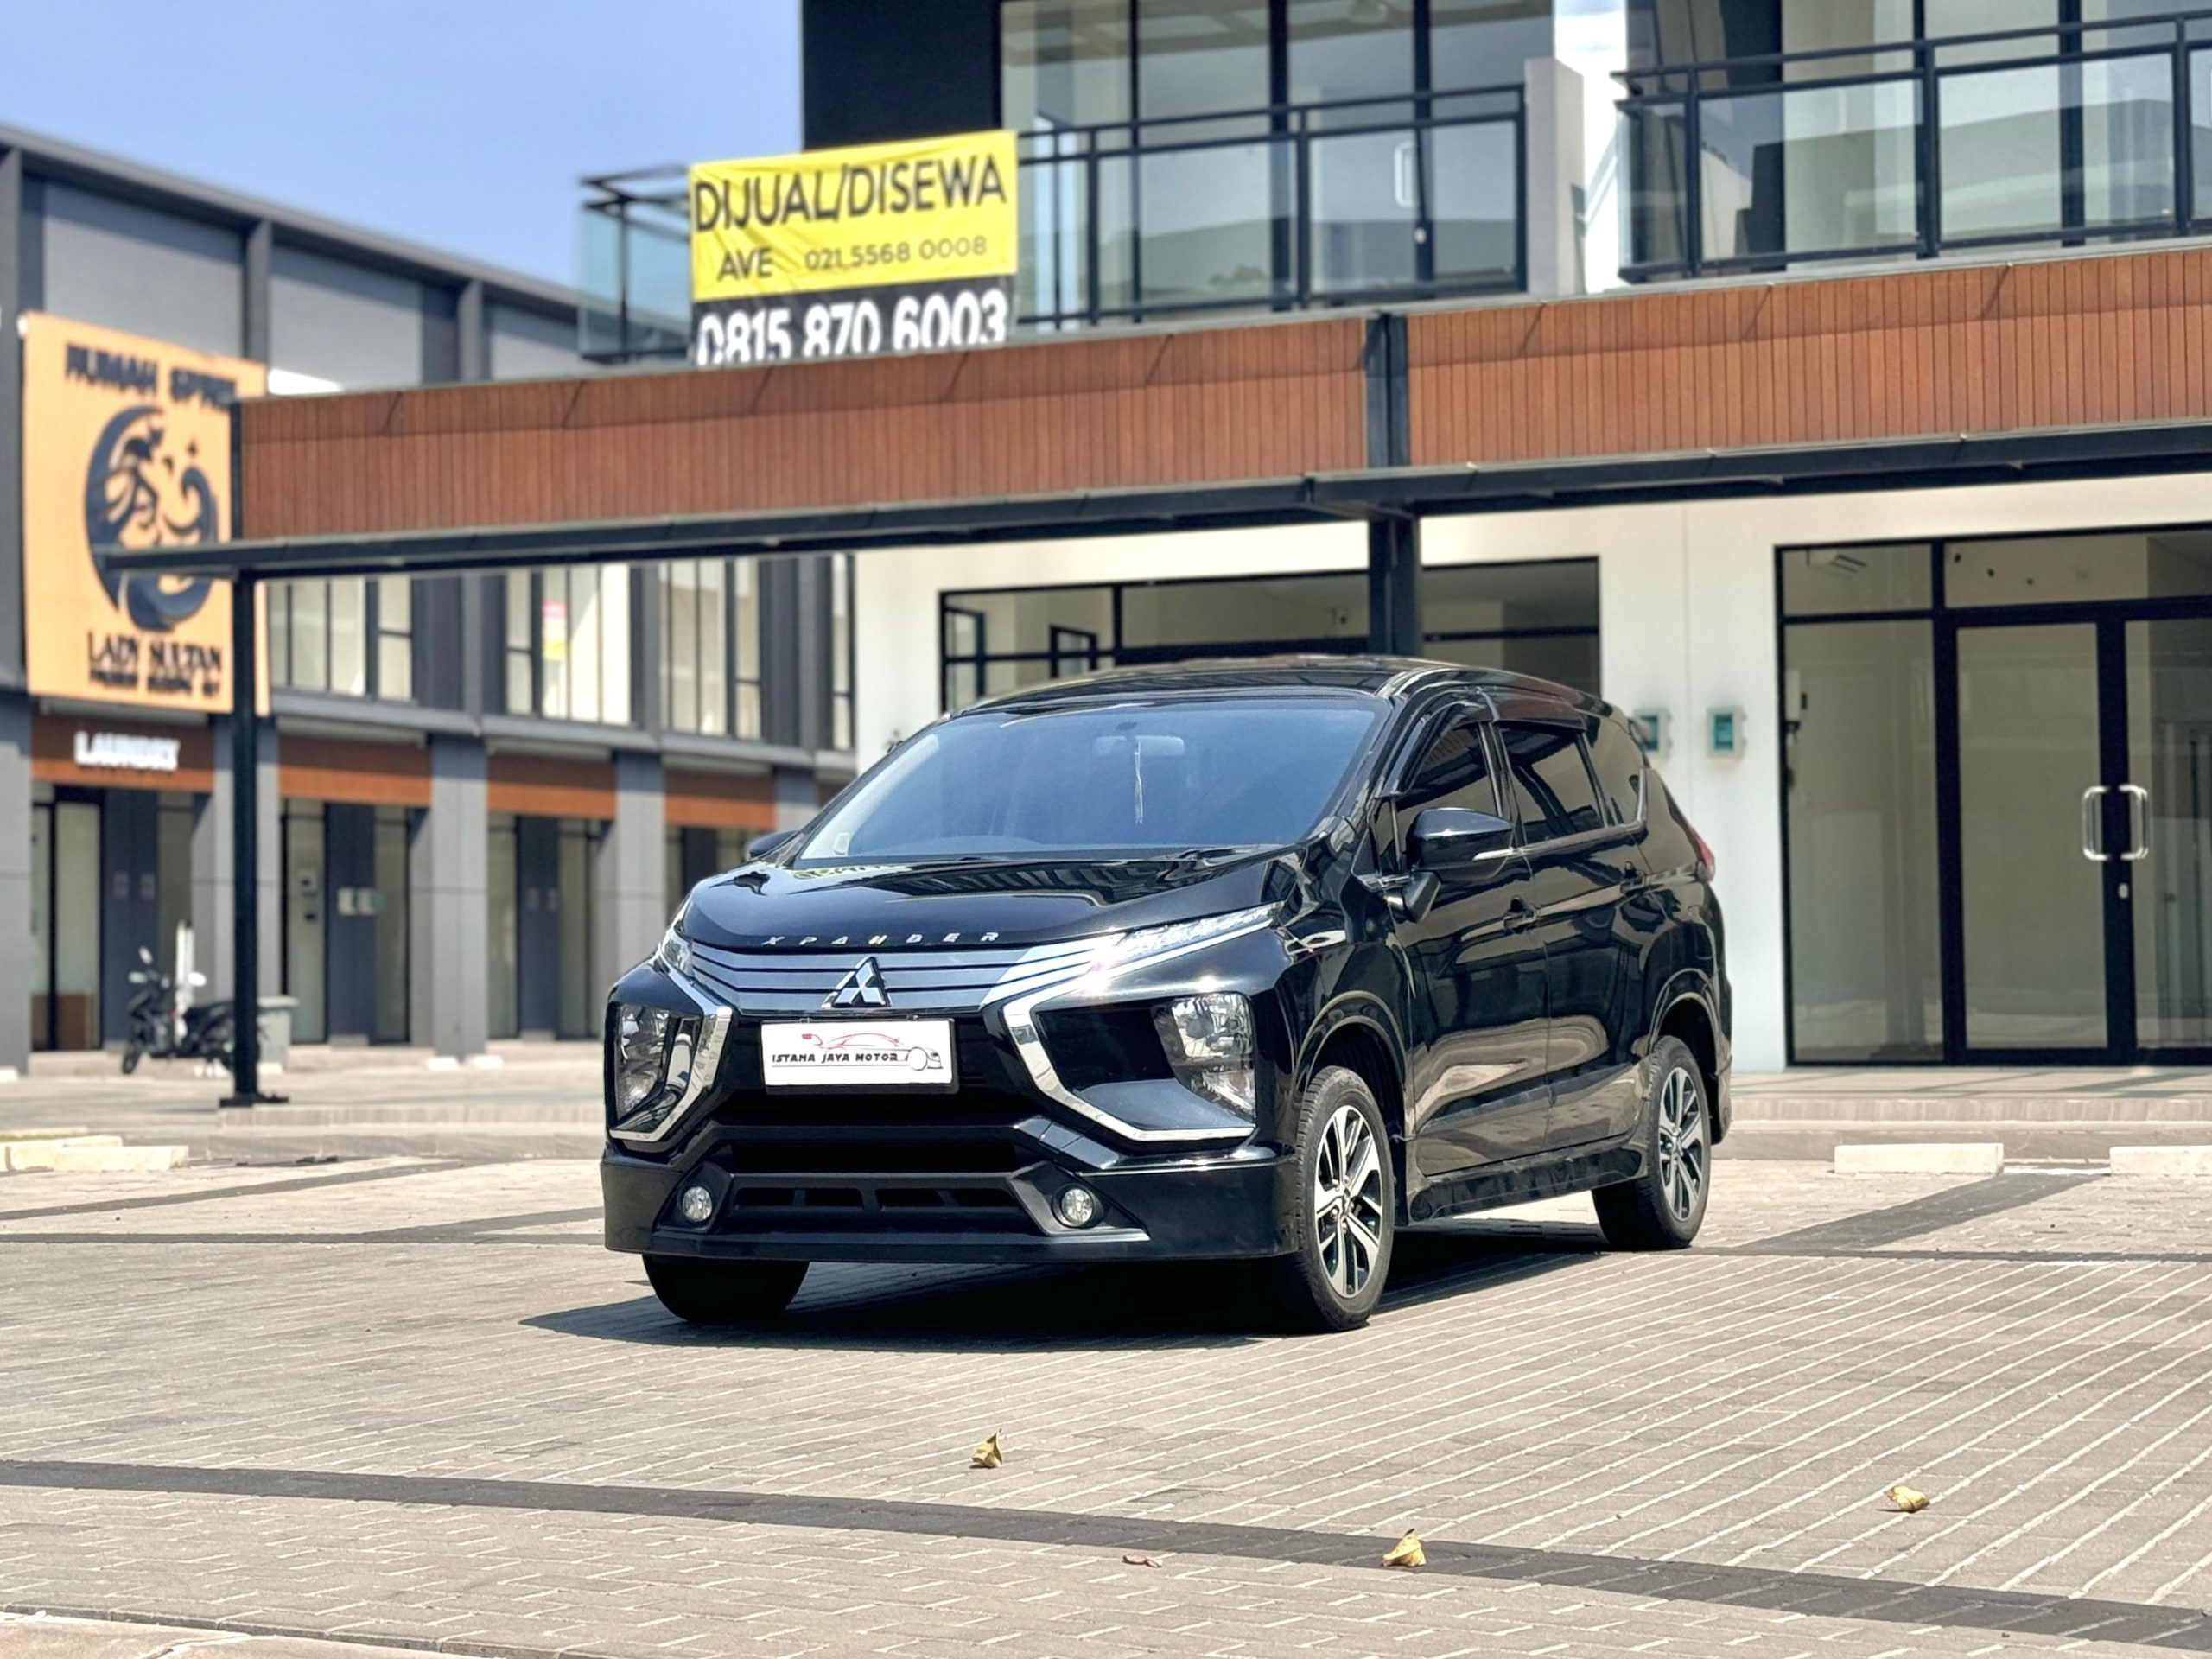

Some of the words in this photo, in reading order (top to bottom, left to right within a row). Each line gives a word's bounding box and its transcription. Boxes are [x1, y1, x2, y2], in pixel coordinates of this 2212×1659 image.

[696, 154, 1007, 232] DIJUAL/DISEWA
[717, 247, 773, 282] AVE
[918, 236, 987, 261] 0008
[696, 311, 792, 365] 0815
[804, 300, 881, 357] 870
[892, 288, 1007, 350] 6003
[761, 931, 999, 945] XPANDER
[772, 1053, 816, 1064] ISTANA
[821, 1053, 850, 1064] JAYA
[855, 1052, 899, 1063] MOTOR
